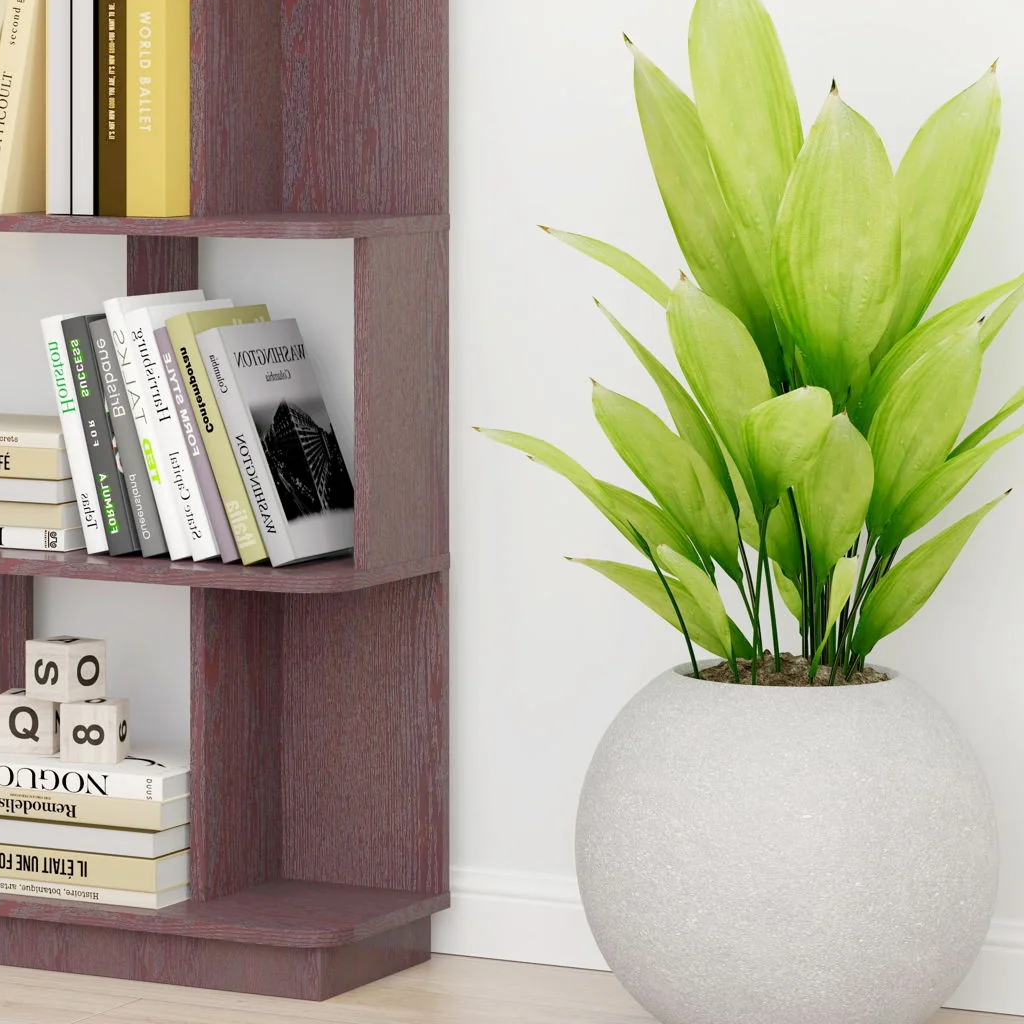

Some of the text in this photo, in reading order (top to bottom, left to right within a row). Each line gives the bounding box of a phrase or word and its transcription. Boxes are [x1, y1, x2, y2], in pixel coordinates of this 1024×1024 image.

[9, 7, 21, 45] second
[139, 12, 152, 132] WORLD BALLET
[34, 658, 59, 686] S
[8, 706, 40, 742] Q
[72, 724, 105, 746] 8
[16, 854, 39, 873] UNE
[42, 856, 74, 880] ÉTAIT
[77, 860, 88, 878] IL
[0, 882, 17, 890] arts
[19, 884, 62, 896] botanique,
[63, 888, 99, 900] Histoire,
